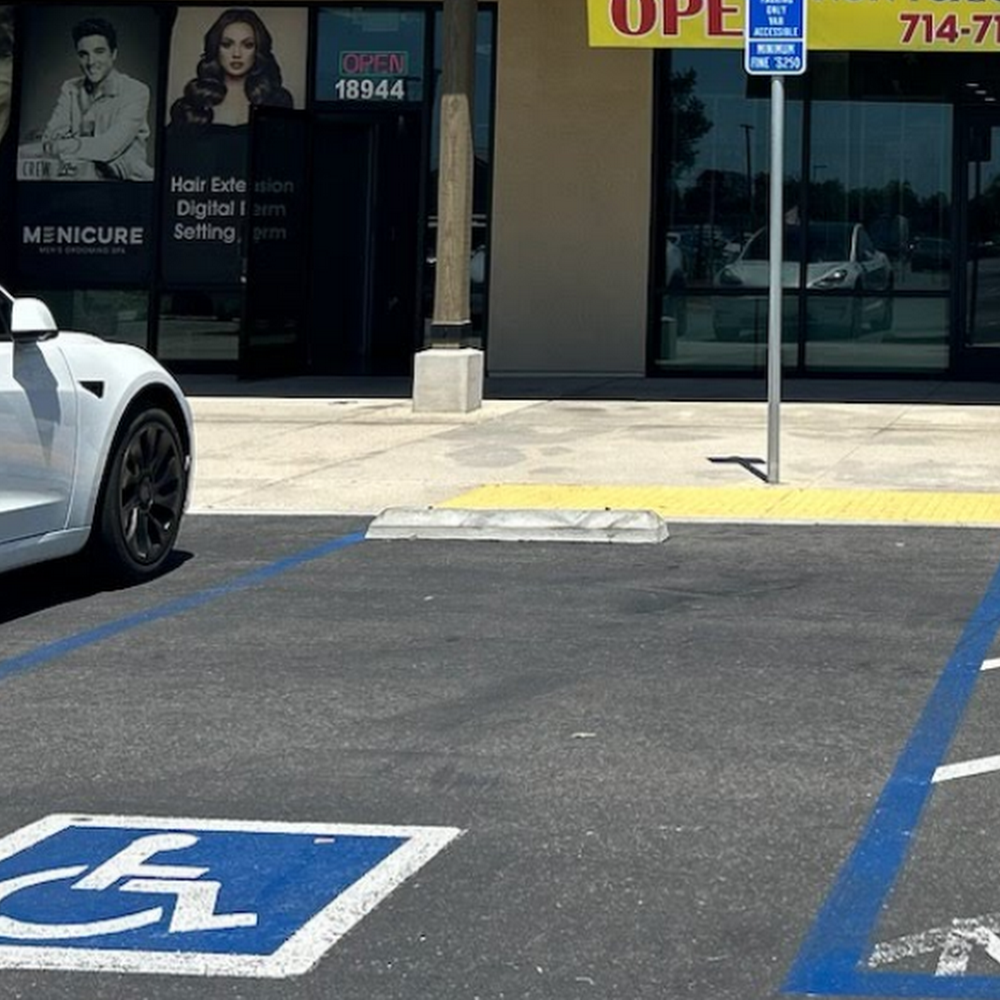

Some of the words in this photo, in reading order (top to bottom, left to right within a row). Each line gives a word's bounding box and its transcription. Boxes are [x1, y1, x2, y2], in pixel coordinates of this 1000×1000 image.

[343, 53, 405, 73] OPEN
[335, 79, 405, 100] 18944
[170, 176, 206, 192] Hair
[177, 199, 235, 219] Digital
[22, 226, 144, 244] MENICURE
[173, 222, 235, 244] Setting
